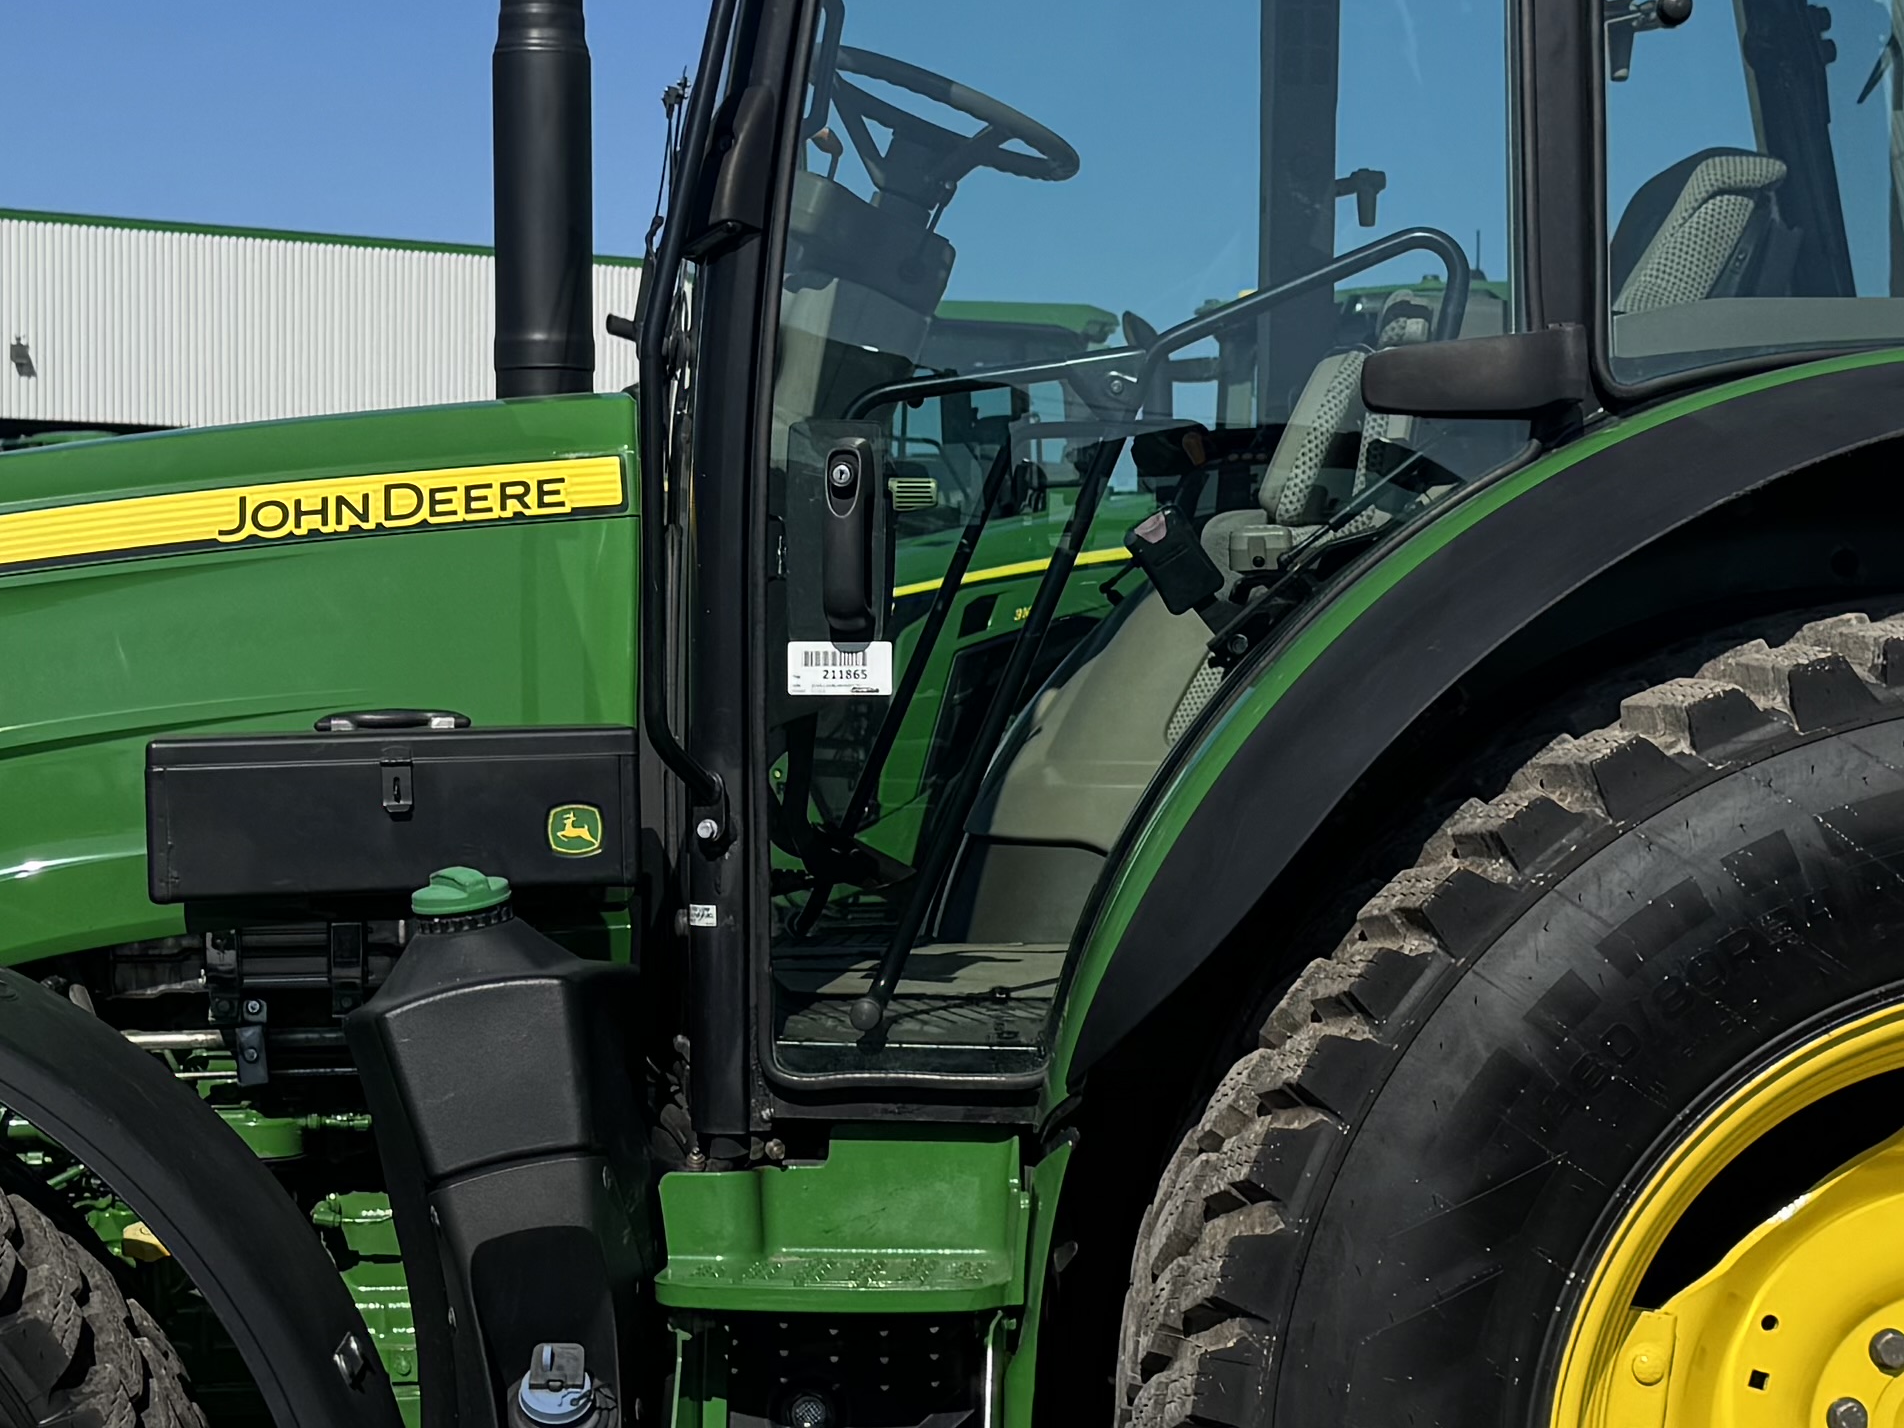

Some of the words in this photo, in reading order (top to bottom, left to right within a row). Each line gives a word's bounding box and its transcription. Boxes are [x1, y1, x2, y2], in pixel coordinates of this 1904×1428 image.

[217, 492, 370, 536] JOHN
[383, 477, 566, 522] DEERE
[822, 669, 868, 680] 211865
